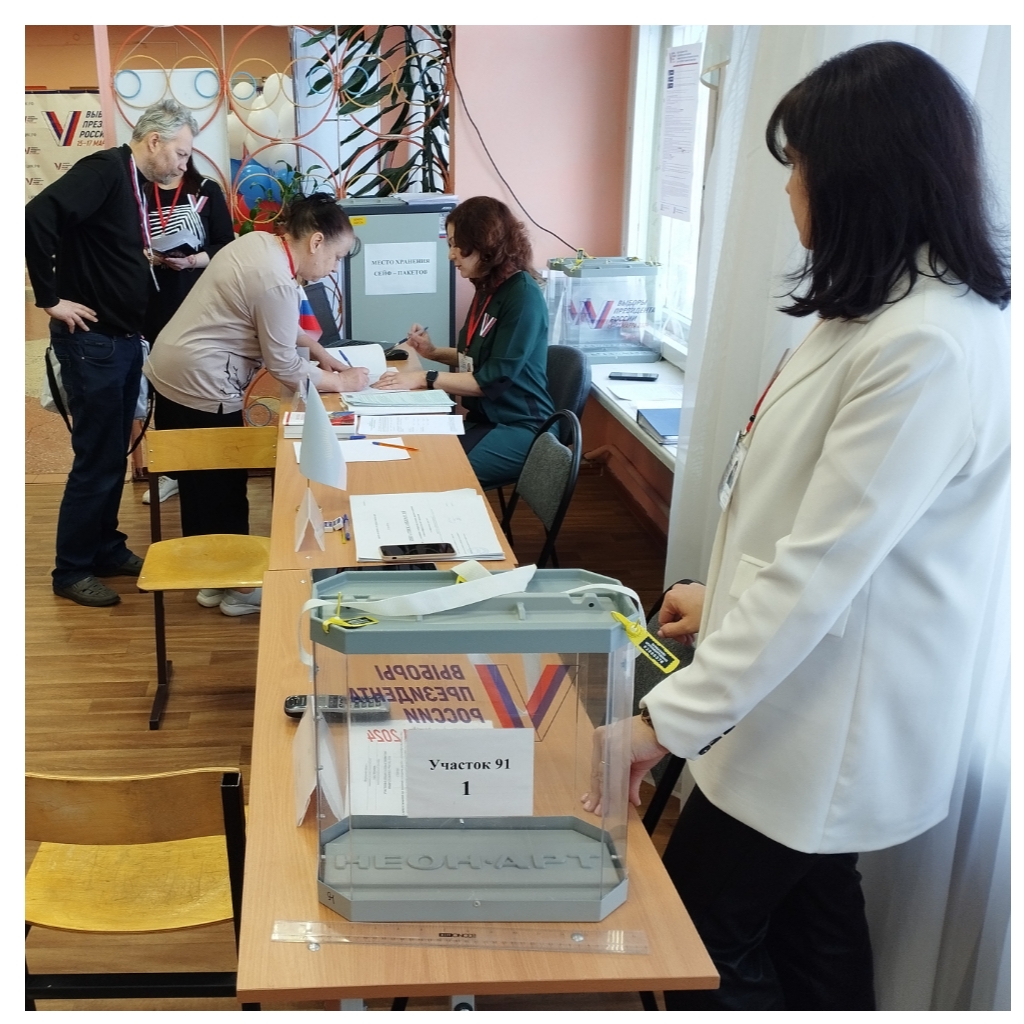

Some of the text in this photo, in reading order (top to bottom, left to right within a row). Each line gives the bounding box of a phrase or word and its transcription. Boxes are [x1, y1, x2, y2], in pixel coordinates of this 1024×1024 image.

[429, 759, 510, 771] Участок 91
[461, 781, 470, 796] 1
